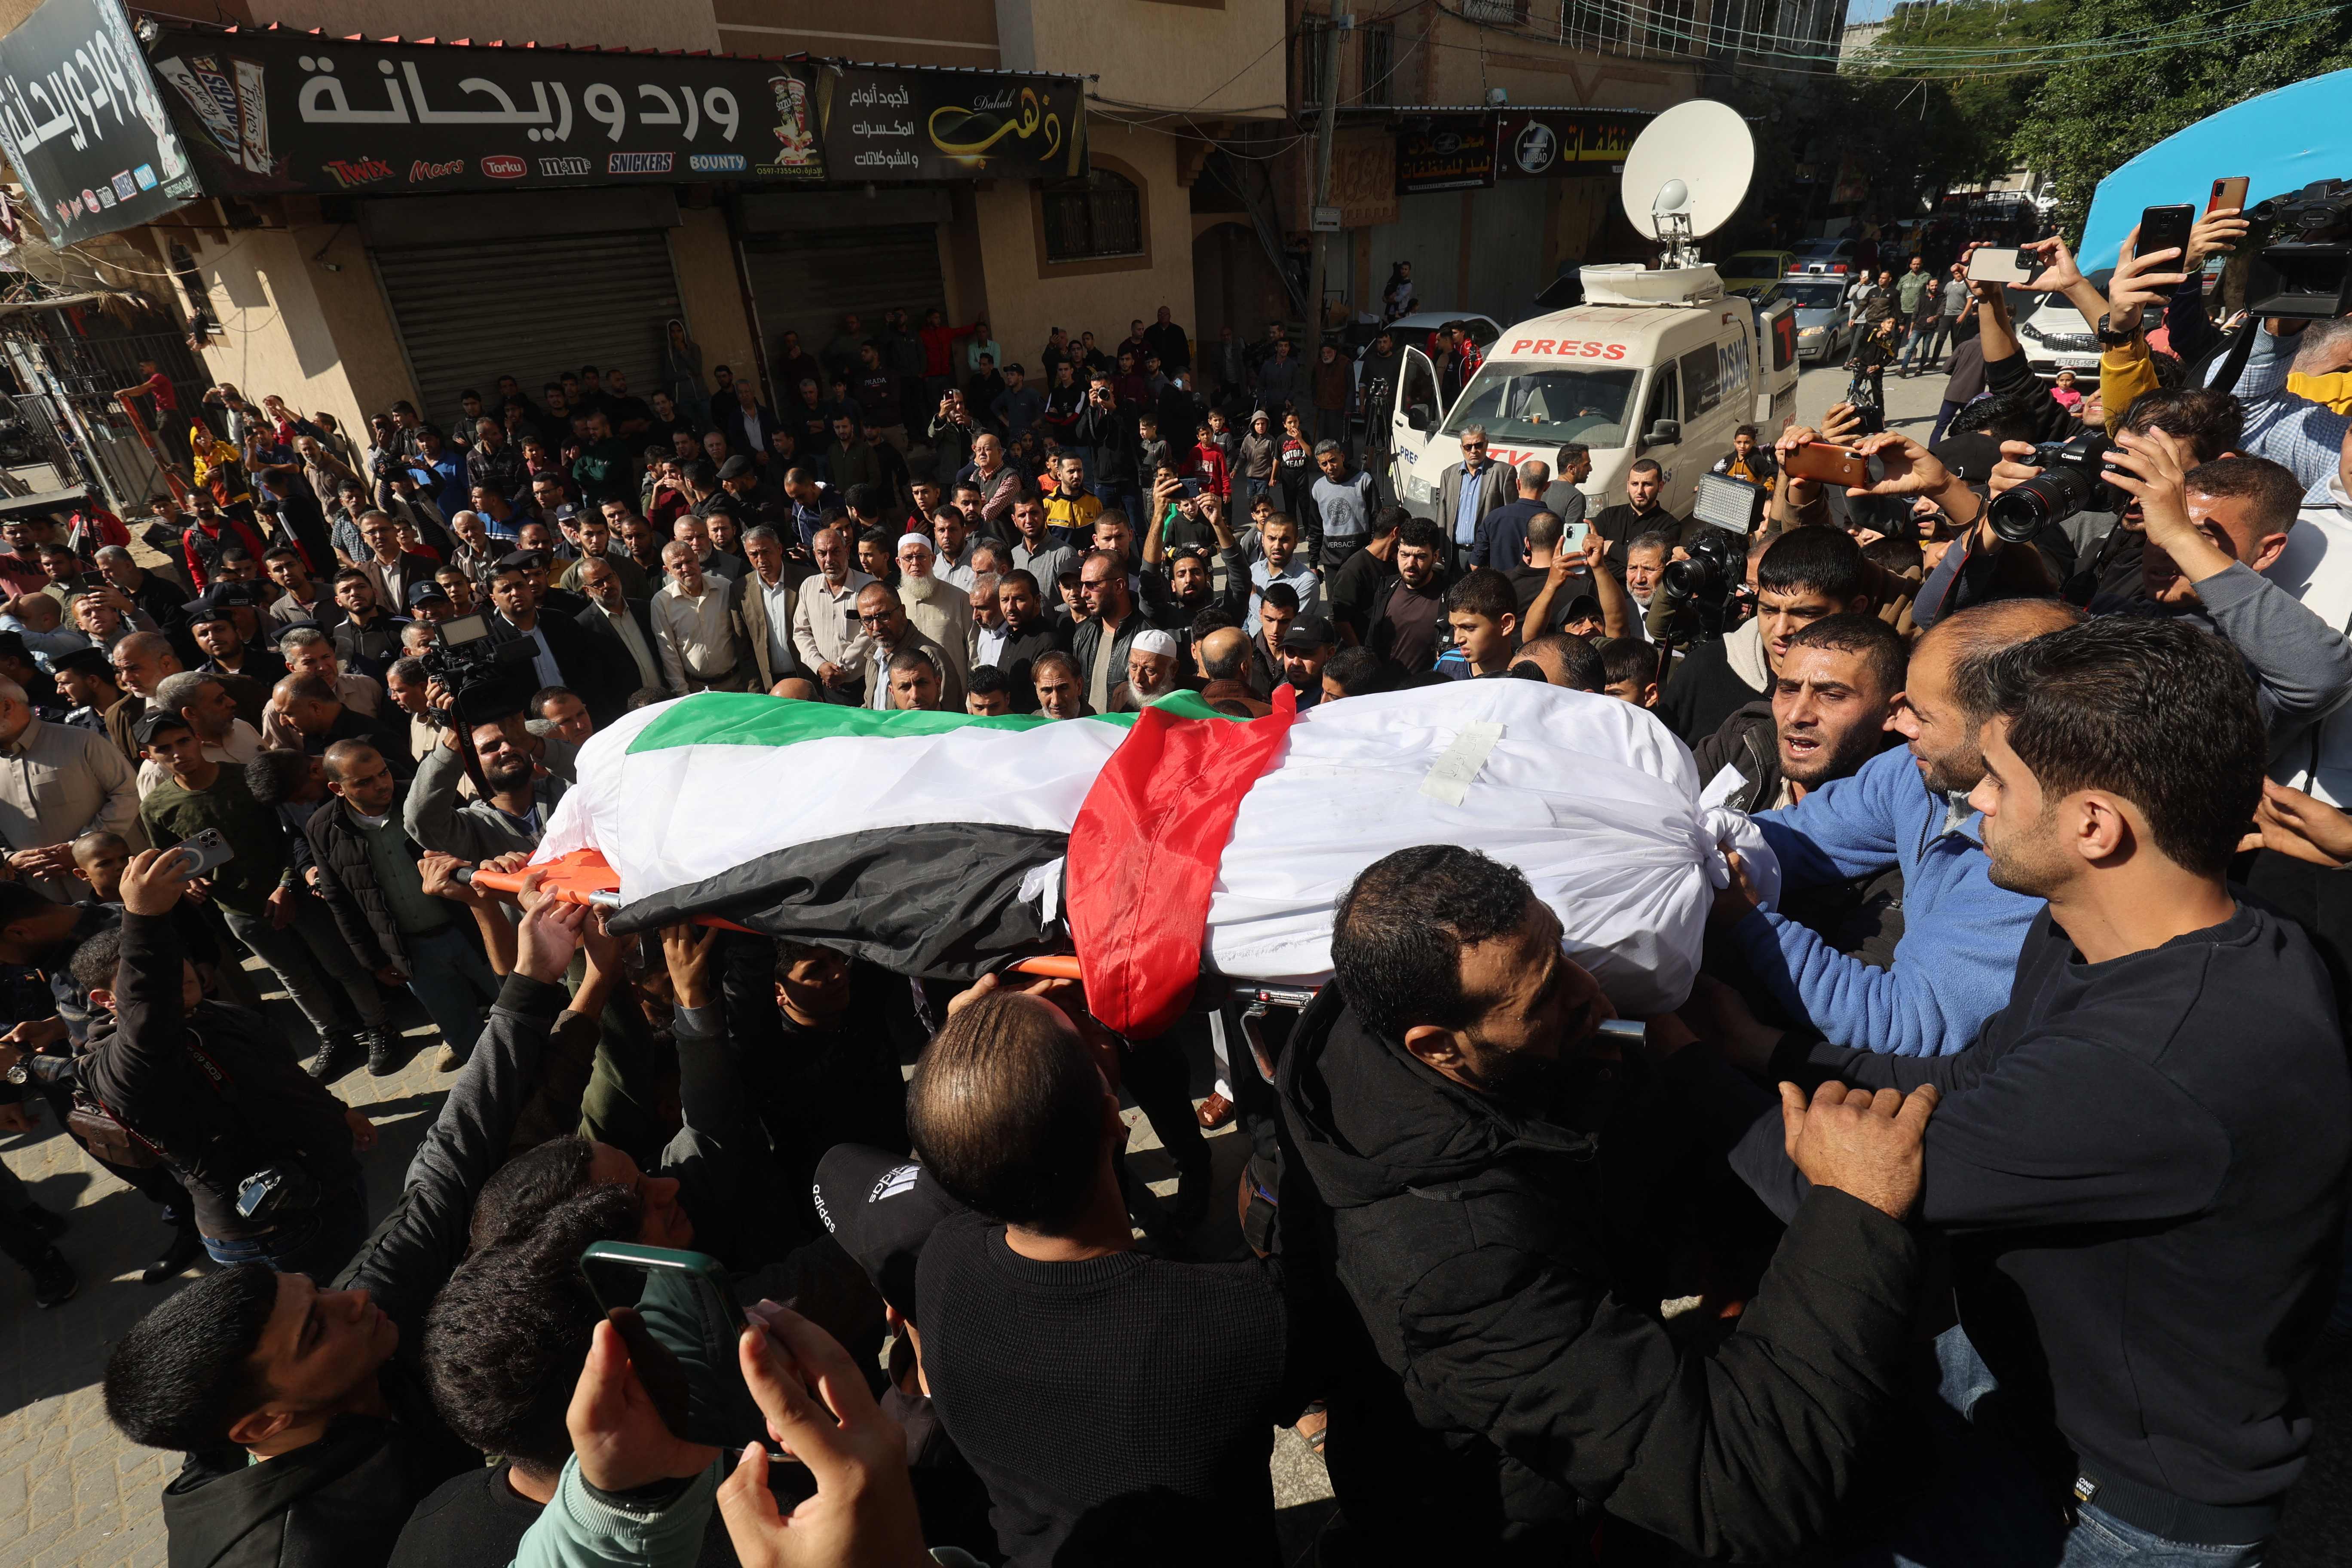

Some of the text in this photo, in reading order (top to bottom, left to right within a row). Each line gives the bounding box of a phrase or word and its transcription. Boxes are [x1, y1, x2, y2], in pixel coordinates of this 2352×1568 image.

[850, 83, 909, 108] لأجود أنواع
[974, 89, 1016, 110] Dahab
[639, 83, 739, 143] ورد
[852, 119, 914, 139] المكسرات
[928, 87, 1061, 169] ذهب
[1523, 153, 1547, 163] LUBBAD
[409, 159, 464, 184] Mars
[487, 162, 521, 174] Torku
[610, 153, 671, 173] SNICKERS
[690, 155, 744, 170] BOUNTY
[1510, 339, 1627, 360] PRESS
[864, 377, 887, 386] PRADA
[1286, 459, 1305, 468] TEAM
[1486, 448, 1534, 466] TV
[1327, 540, 1357, 548] VERSACE
[460, 722, 471, 747] Canon
[203, 1061, 222, 1081] EOS
[813, 1184, 835, 1233] adidas
[2076, 1481, 2092, 1496] WAY
[2078, 1477, 2095, 1490] ONE
